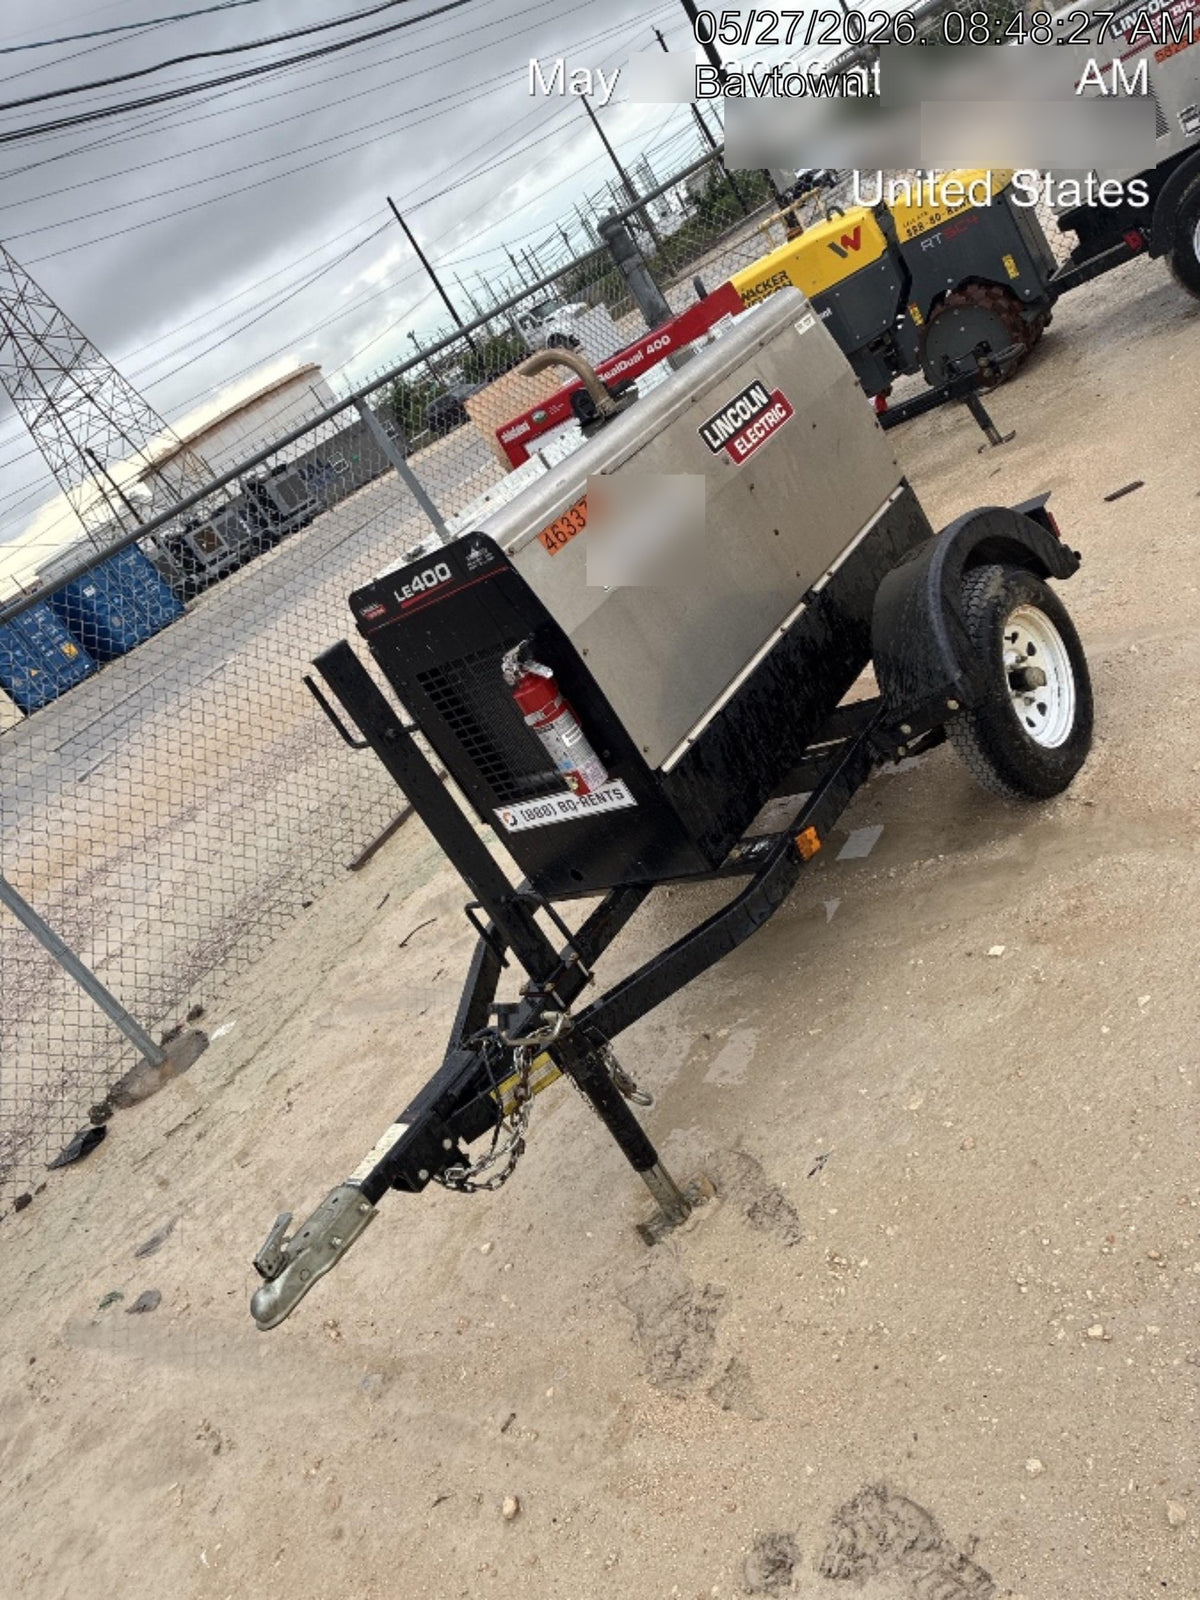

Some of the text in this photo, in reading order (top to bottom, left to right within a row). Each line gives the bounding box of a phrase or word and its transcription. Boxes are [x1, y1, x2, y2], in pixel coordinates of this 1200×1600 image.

[646, 334, 672, 355] 400
[703, 384, 770, 449] LINCOLN
[733, 401, 787, 457] ELECTRIC
[394, 562, 453, 602] LE400
